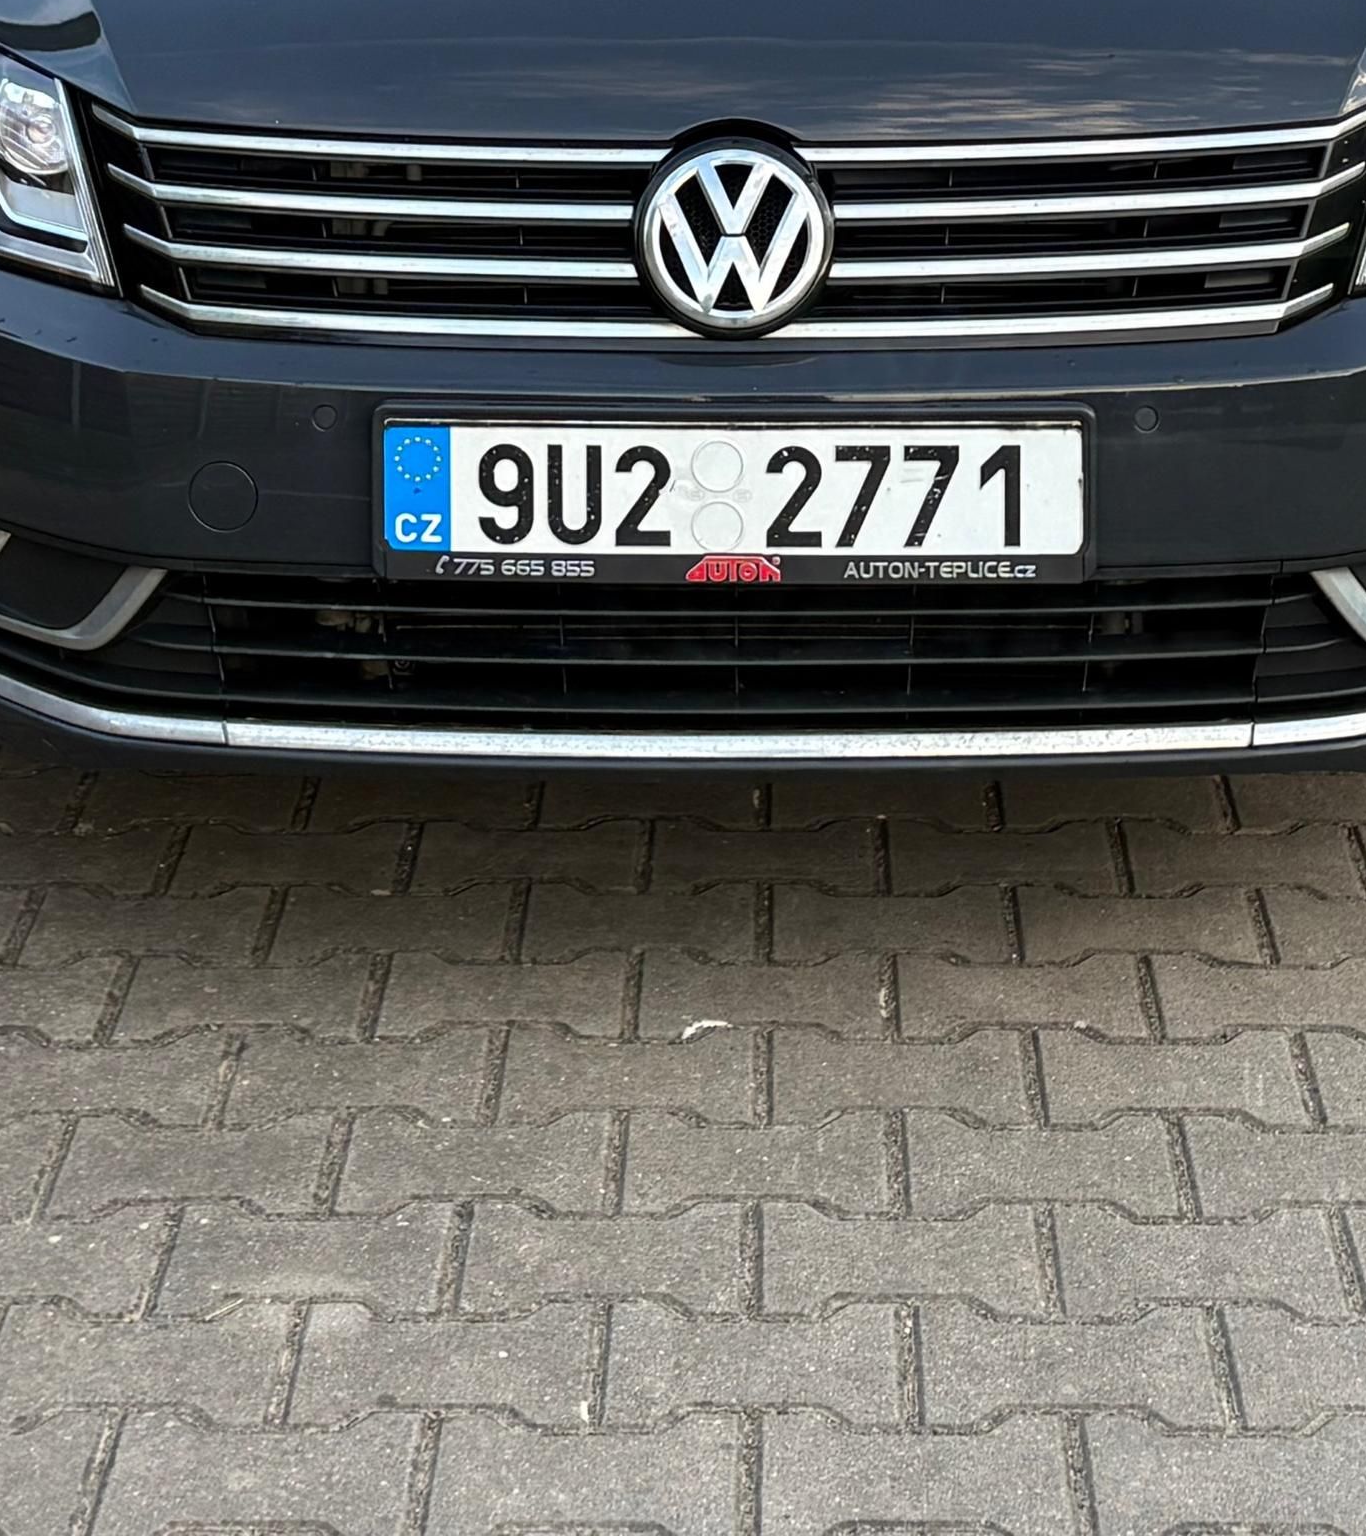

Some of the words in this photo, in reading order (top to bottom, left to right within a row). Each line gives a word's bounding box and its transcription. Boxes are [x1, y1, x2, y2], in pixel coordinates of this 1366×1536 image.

[650, 156, 817, 318] VW
[394, 512, 443, 543] CZ
[477, 443, 672, 547] 9U2
[765, 444, 1022, 548] 2771
[453, 557, 495, 576] 775
[501, 558, 545, 576] 665
[551, 559, 596, 577] 855
